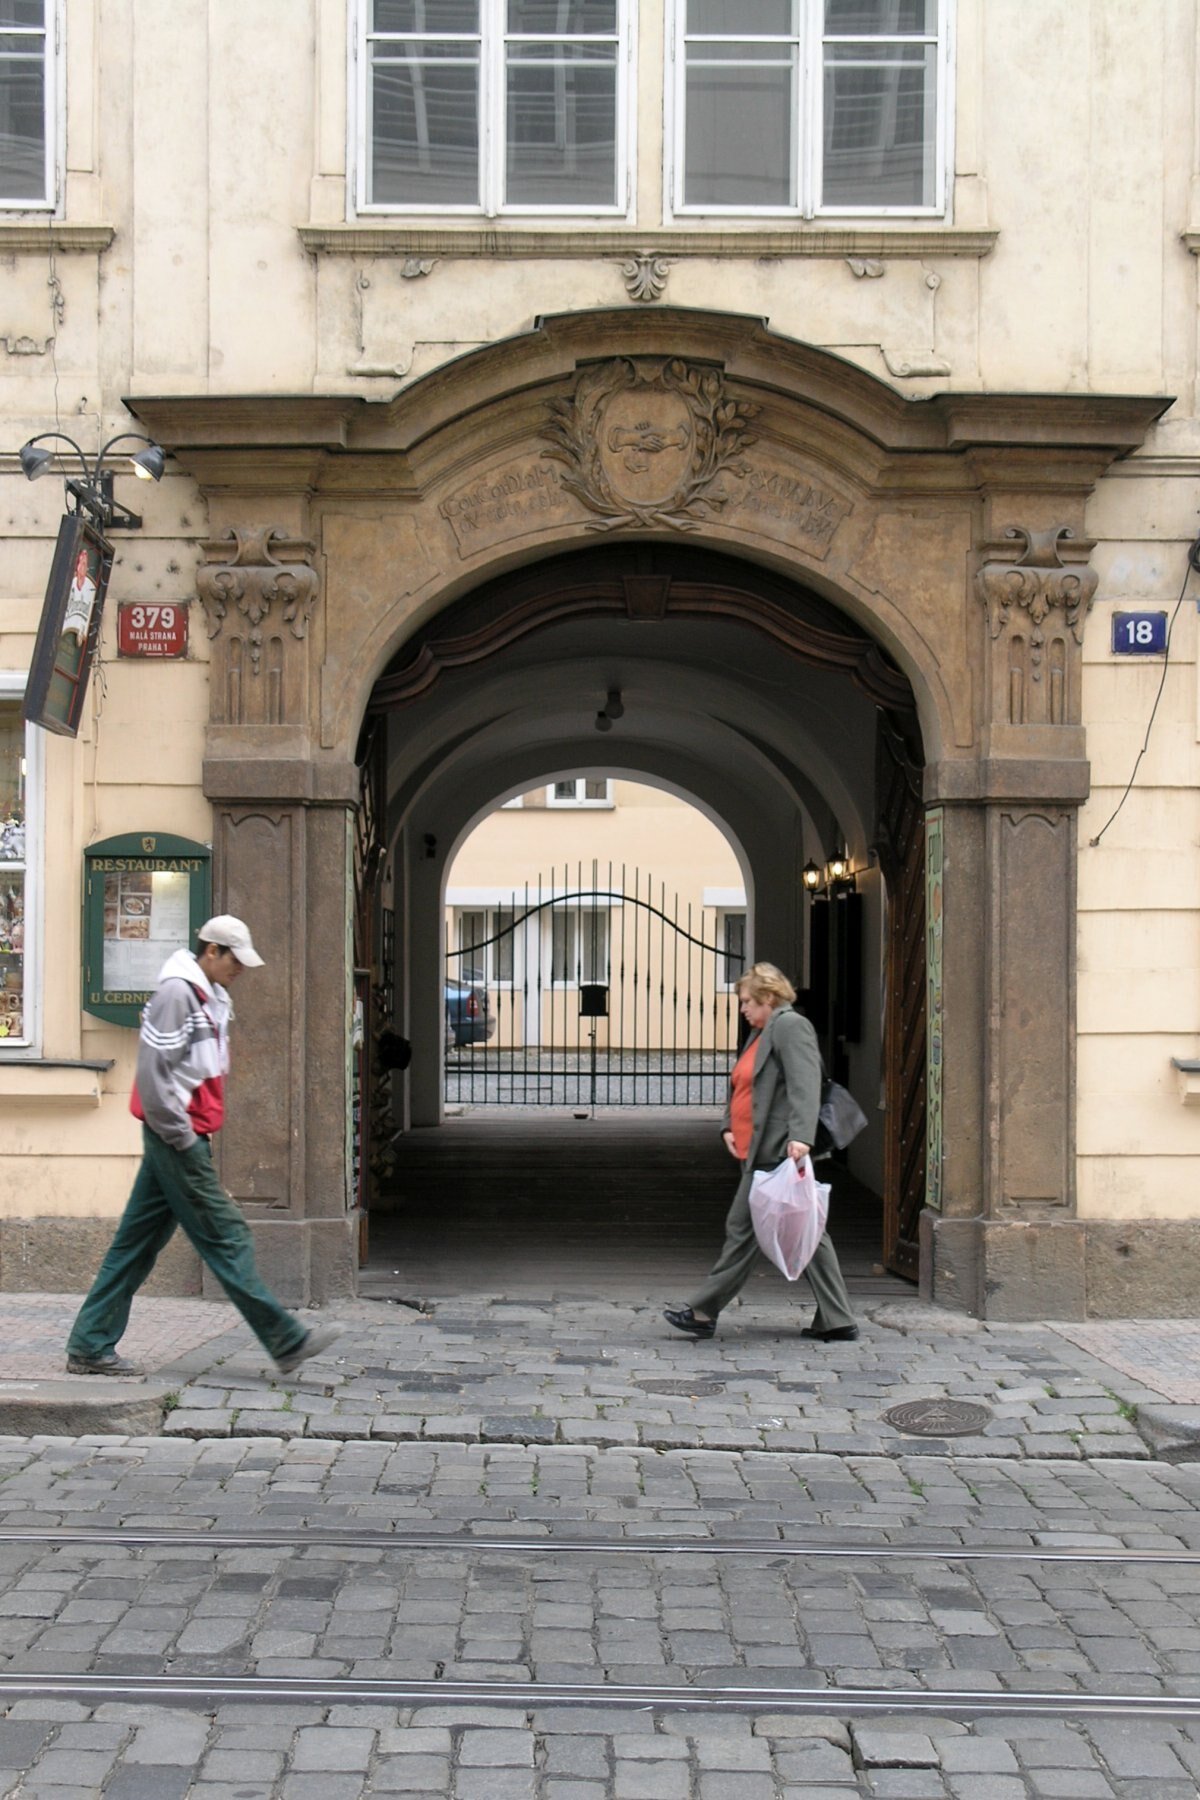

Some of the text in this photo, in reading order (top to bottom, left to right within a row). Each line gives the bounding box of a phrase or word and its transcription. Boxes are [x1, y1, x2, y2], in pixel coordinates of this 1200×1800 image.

[131, 607, 175, 629] 379
[129, 630, 177, 641] MALÁ STRANA
[1126, 620, 1153, 644] 18
[138, 643, 162, 651] PRAHA
[91, 858, 203, 872] RESTAURANT
[91, 992, 100, 1003] U
